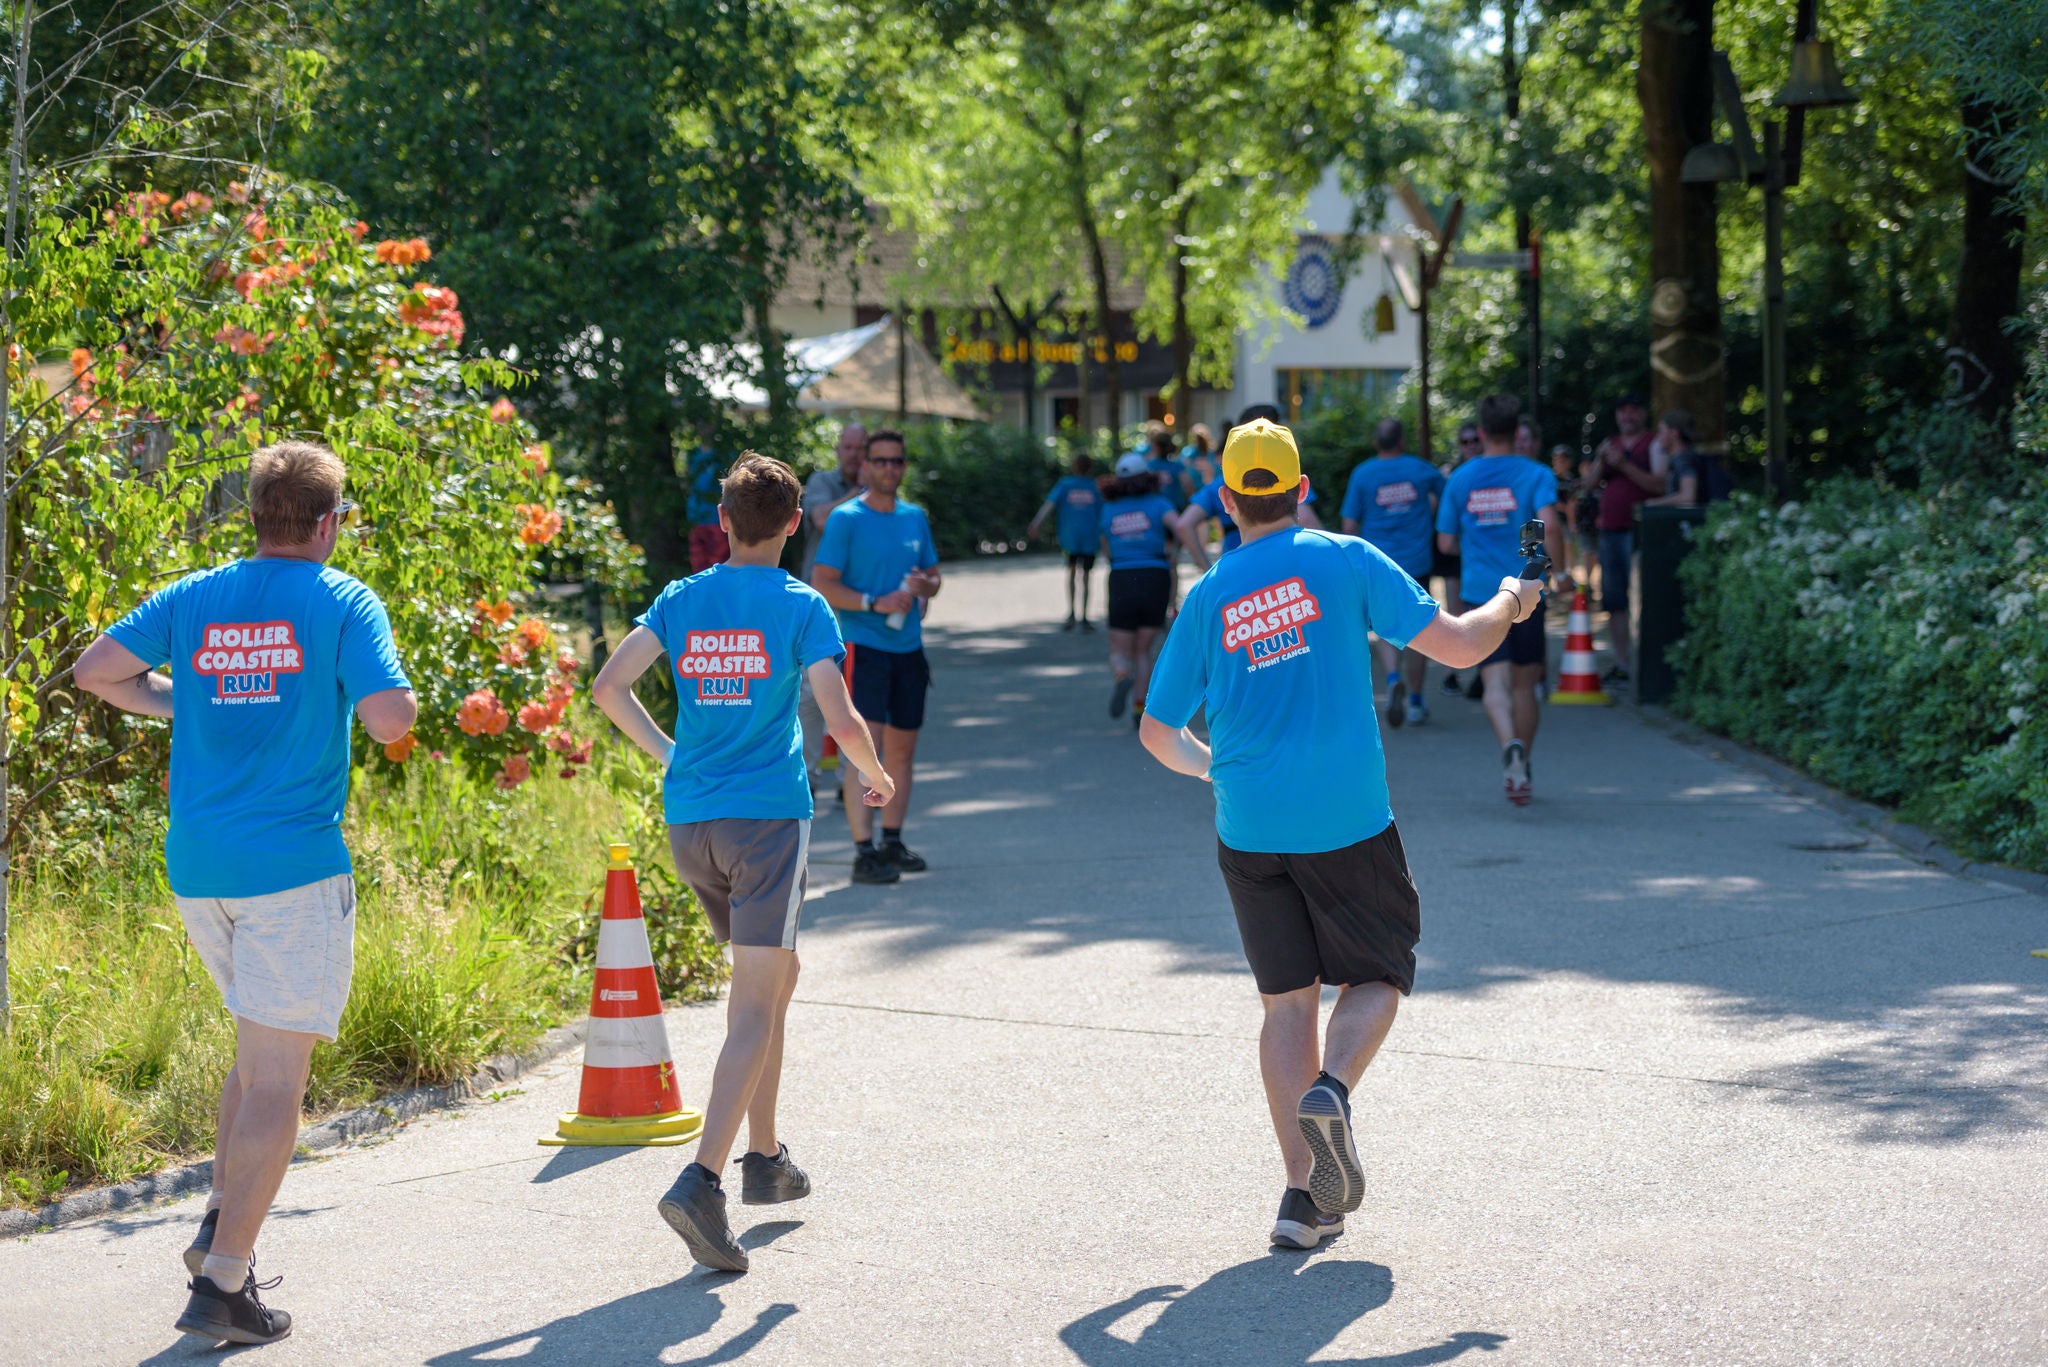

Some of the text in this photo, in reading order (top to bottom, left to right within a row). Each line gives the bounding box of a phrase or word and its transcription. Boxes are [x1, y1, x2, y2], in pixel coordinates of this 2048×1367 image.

[1225, 582, 1304, 626] ROLLER
[1226, 598, 1317, 648] COASTER
[208, 626, 290, 648] ROLLER
[690, 634, 760, 653] ROLLER
[1251, 625, 1301, 661] RUN
[198, 648, 300, 670] COASTER
[682, 655, 766, 673] COASTER
[1258, 657, 1280, 669] FIGHT
[1281, 645, 1311, 661] CANCER
[222, 671, 272, 694] RUN
[702, 676, 745, 696] RUN
[224, 696, 248, 705] FIGHT
[248, 695, 281, 704] CANCER
[724, 698, 752, 706] CANCER
